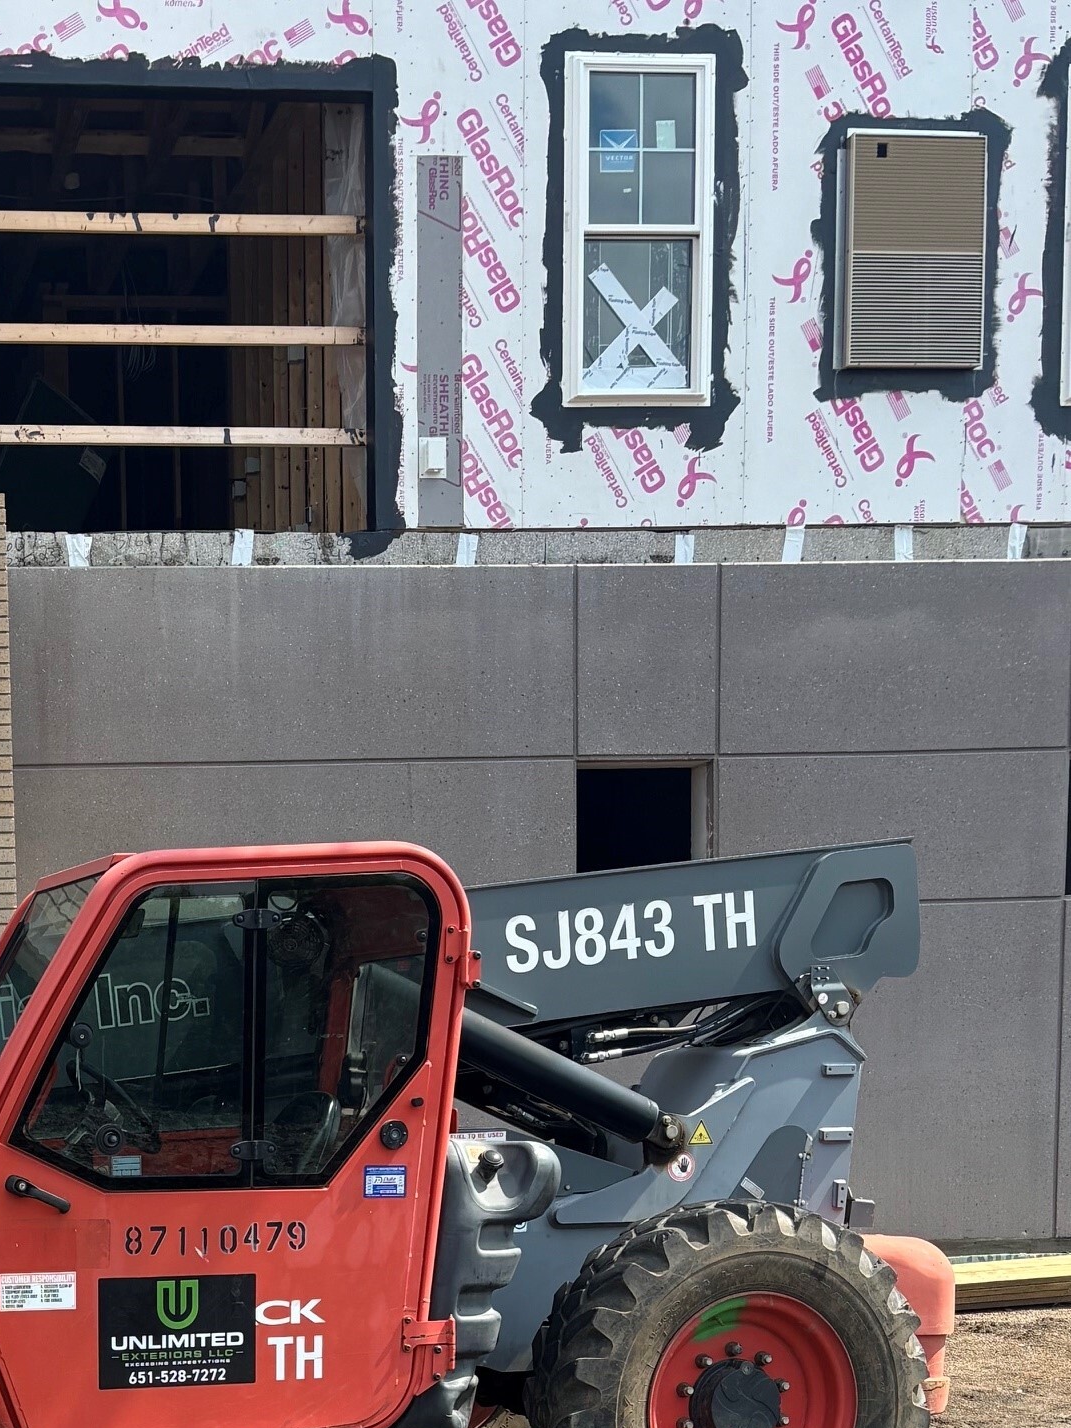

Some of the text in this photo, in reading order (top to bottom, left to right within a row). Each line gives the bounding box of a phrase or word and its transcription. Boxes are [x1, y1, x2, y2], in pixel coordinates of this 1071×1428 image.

[436, 4, 483, 82] CertainTeed
[469, 0, 522, 67] Glas
[868, 0, 913, 77] CertainTeed
[831, 13, 894, 118] GlasRo
[495, 93, 525, 153] Certain
[456, 108, 525, 228] GlasRoc
[494, 338, 524, 396] Certain
[439, 374, 449, 437] SHEATHI
[461, 354, 523, 469] GlasRoc
[583, 433, 628, 508] CertainTeed
[805, 409, 847, 488] CertainTeed
[505, 890, 757, 974] SJ843 TH
[94, 973, 210, 1030] Inc.
[124, 1221, 307, 1257] 87110479
[1, 1273, 75, 1284] CUSTOMER RESPONSIBILITY
[111, 1332, 244, 1351] UNLIMITED
[121, 1348, 234, 1361] EXTERIORS LLC
[172, 1358, 231, 1366] EXPECTATIONS
[267, 1335, 324, 1381] TH
[128, 1367, 226, 1385] 651-528-7272
